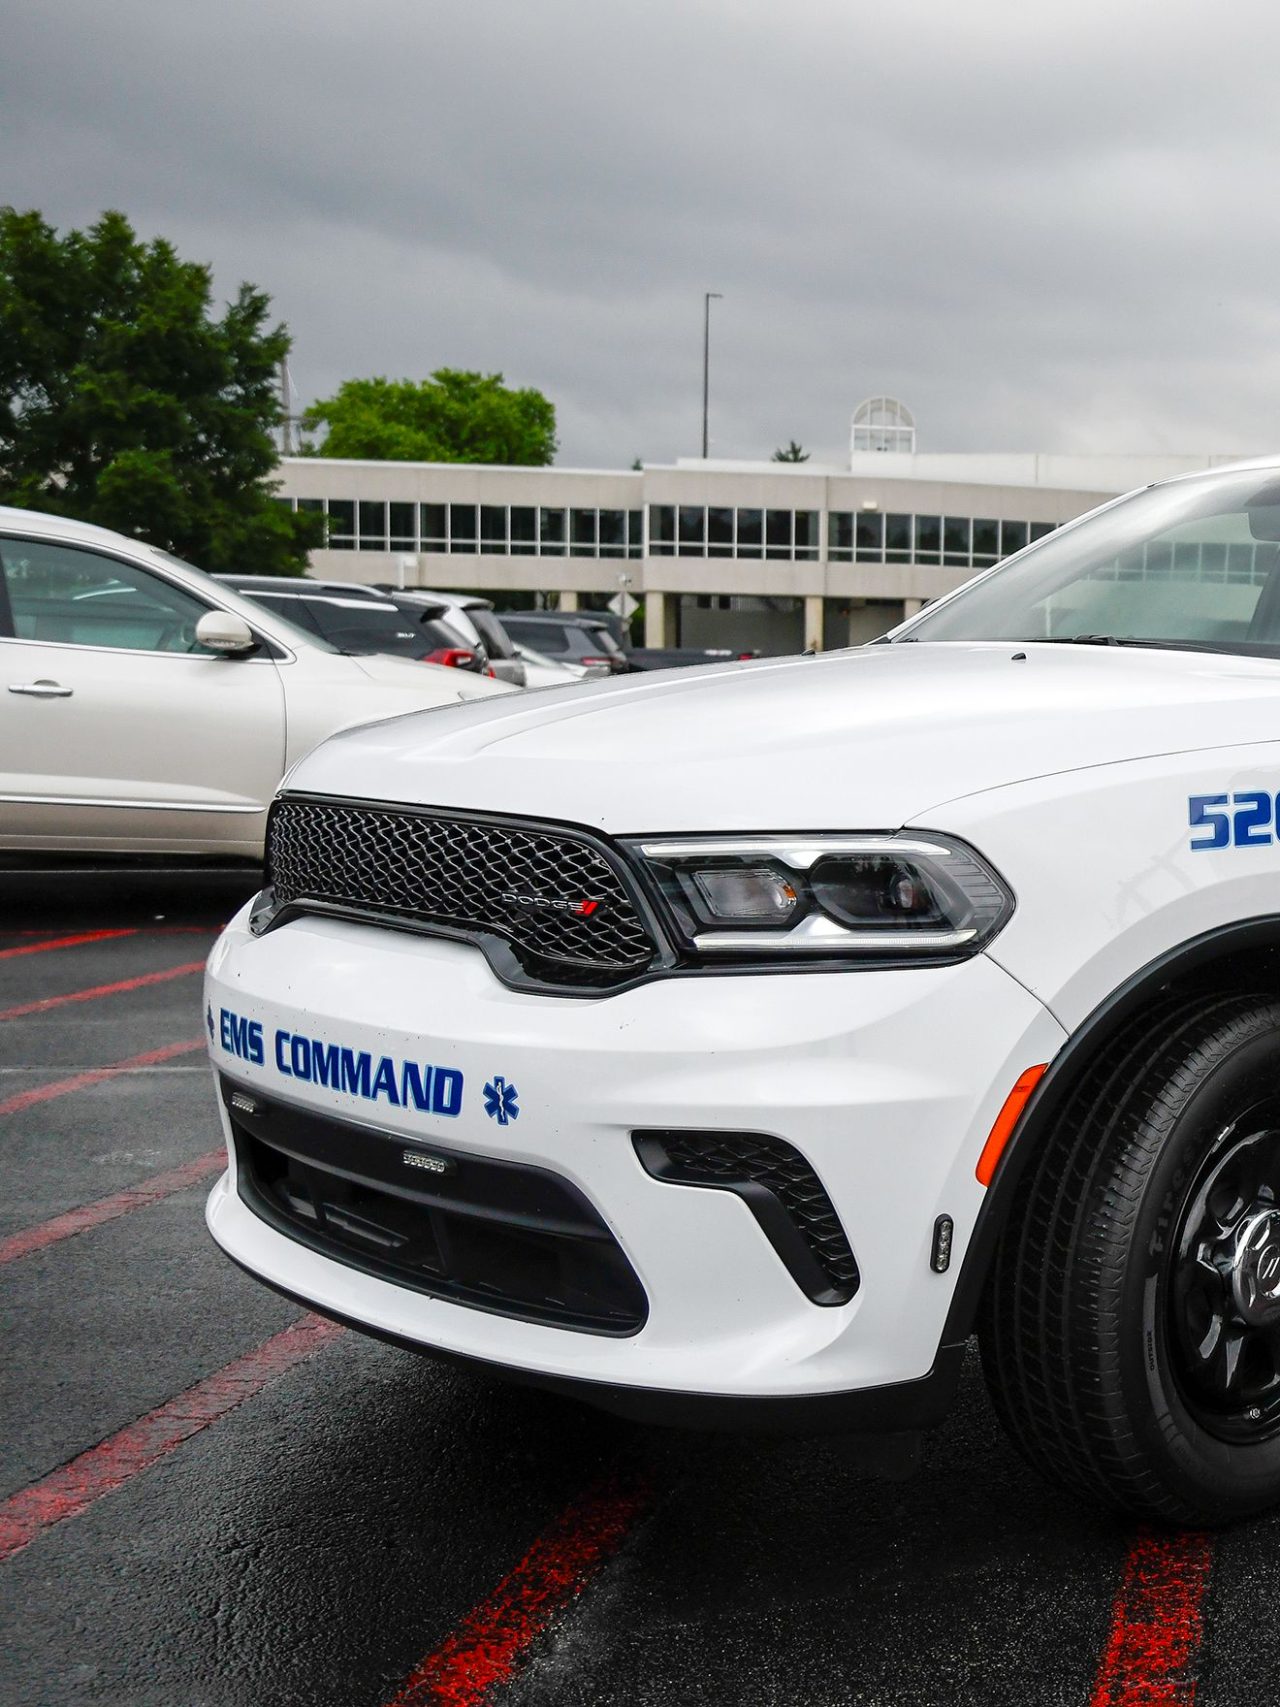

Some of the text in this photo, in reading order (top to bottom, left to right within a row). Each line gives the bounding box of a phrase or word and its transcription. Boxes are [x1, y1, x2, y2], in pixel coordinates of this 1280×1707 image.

[502, 893, 584, 911] DODGE
[219, 1007, 464, 1118] EMS COMMAND
